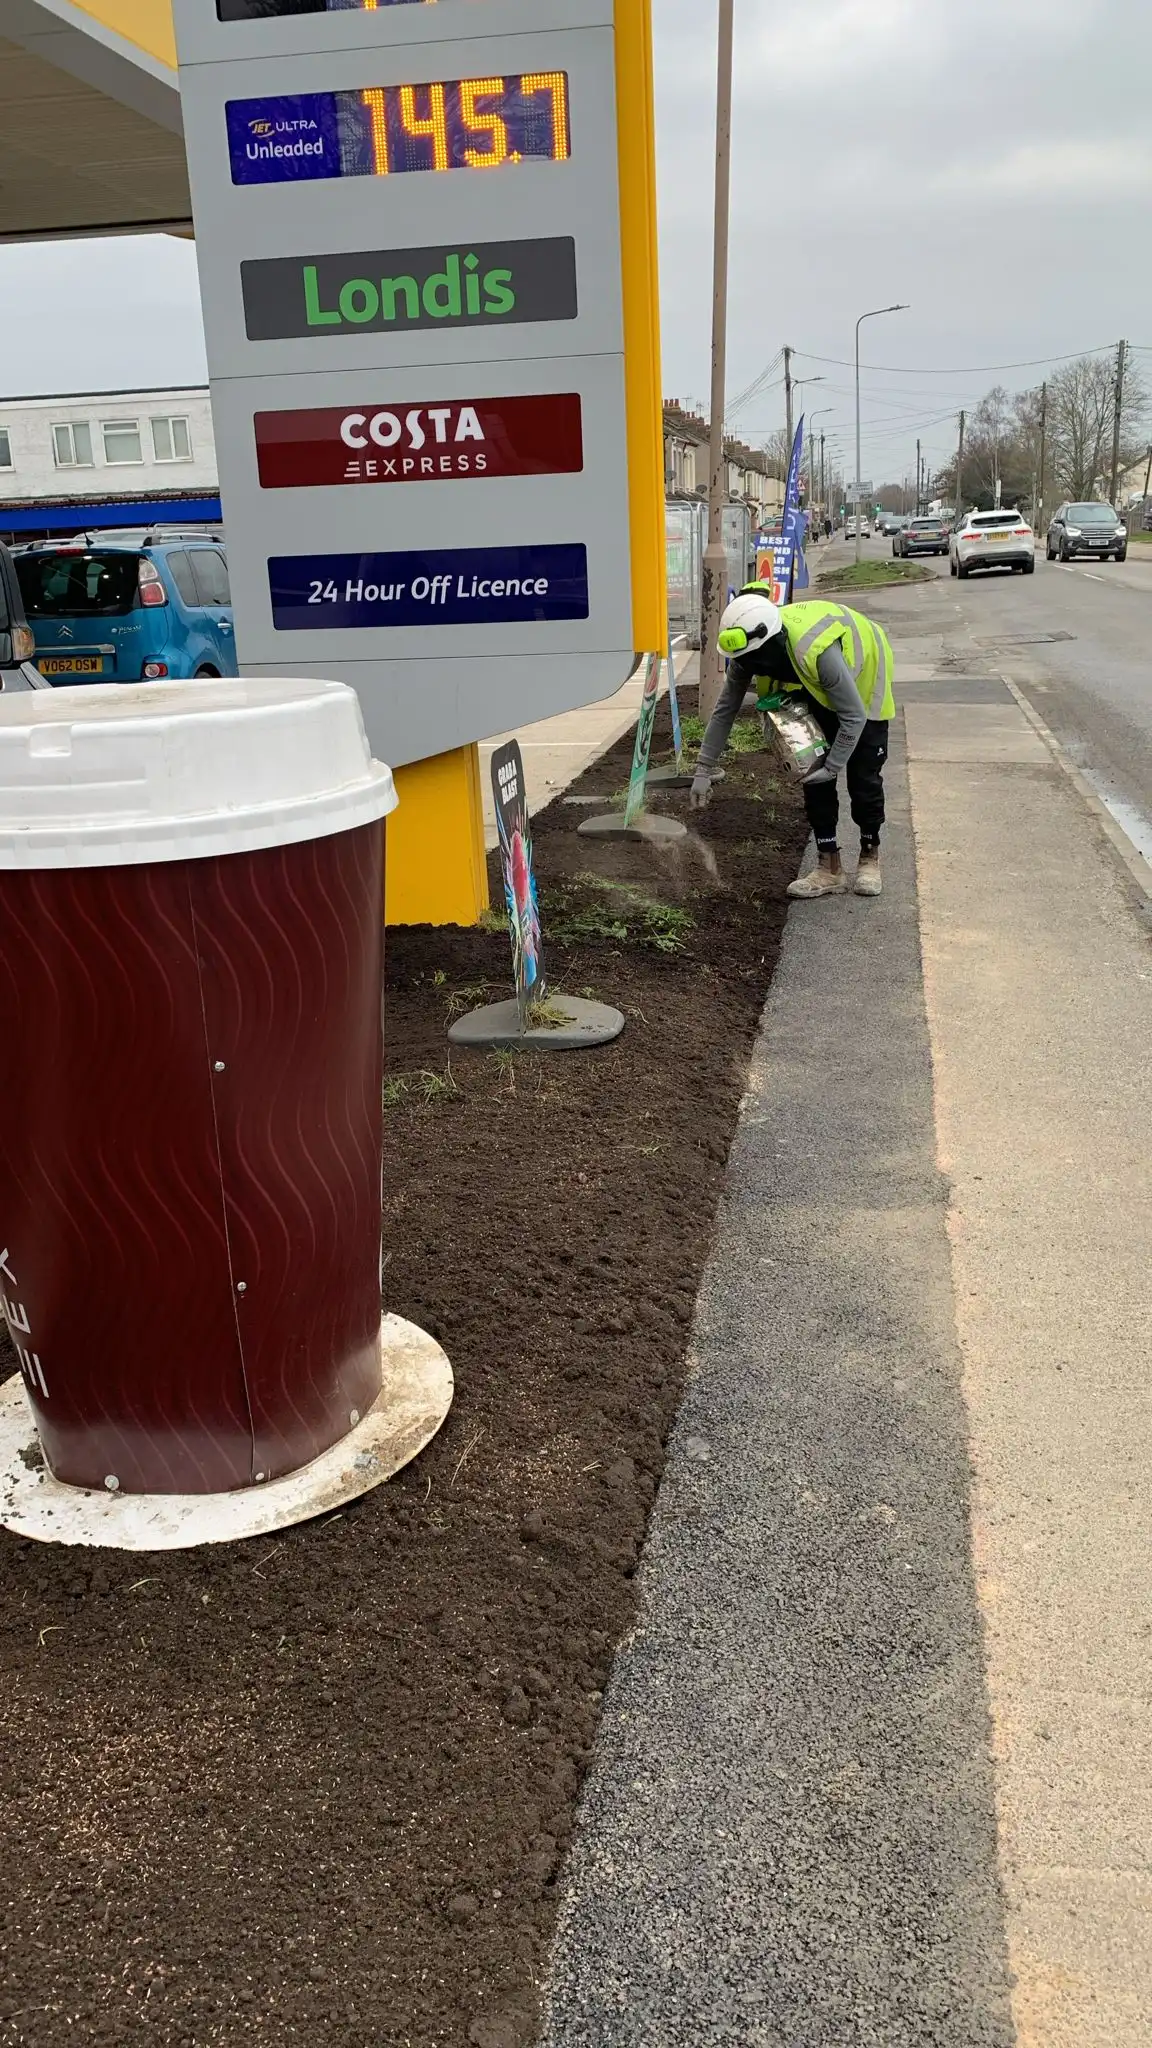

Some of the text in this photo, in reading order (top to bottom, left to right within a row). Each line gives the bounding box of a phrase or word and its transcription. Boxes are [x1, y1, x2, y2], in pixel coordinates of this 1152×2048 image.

[250, 120, 317, 135] JET ULTRA
[363, 72, 567, 174] 145.7
[246, 137, 323, 159] Unleaded
[303, 253, 515, 325] Londis
[340, 407, 485, 450] COSTA
[365, 454, 487, 476] EXPRESS
[760, 536, 791, 545] BEST
[308, 575, 549, 605] 24 Hour Off Licence
[44, 659, 98, 672] VO62 OSW
[501, 778, 518, 805] BLAST
